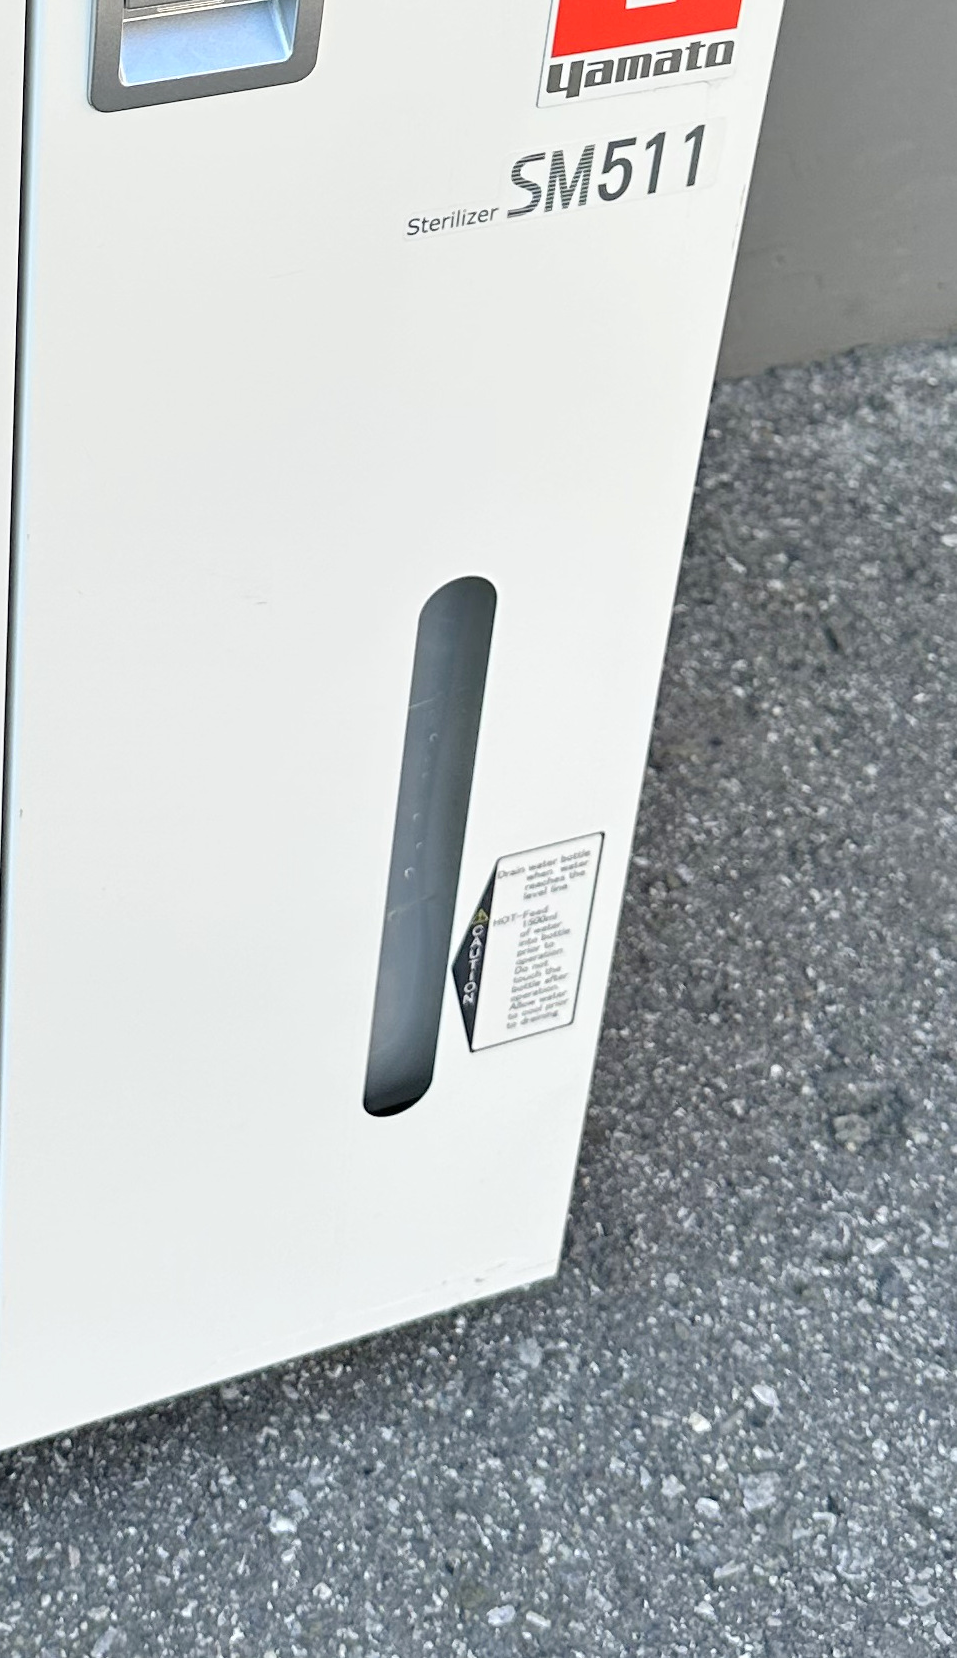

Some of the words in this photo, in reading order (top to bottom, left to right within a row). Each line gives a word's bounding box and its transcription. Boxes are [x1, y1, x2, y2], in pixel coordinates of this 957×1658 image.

[407, 206, 499, 237] Sterilizer
[507, 124, 706, 219] SM511
[498, 867, 525, 879] Drain
[529, 858, 558, 871] water
[561, 849, 591, 862] bottle
[463, 924, 484, 1005] CAUTION
